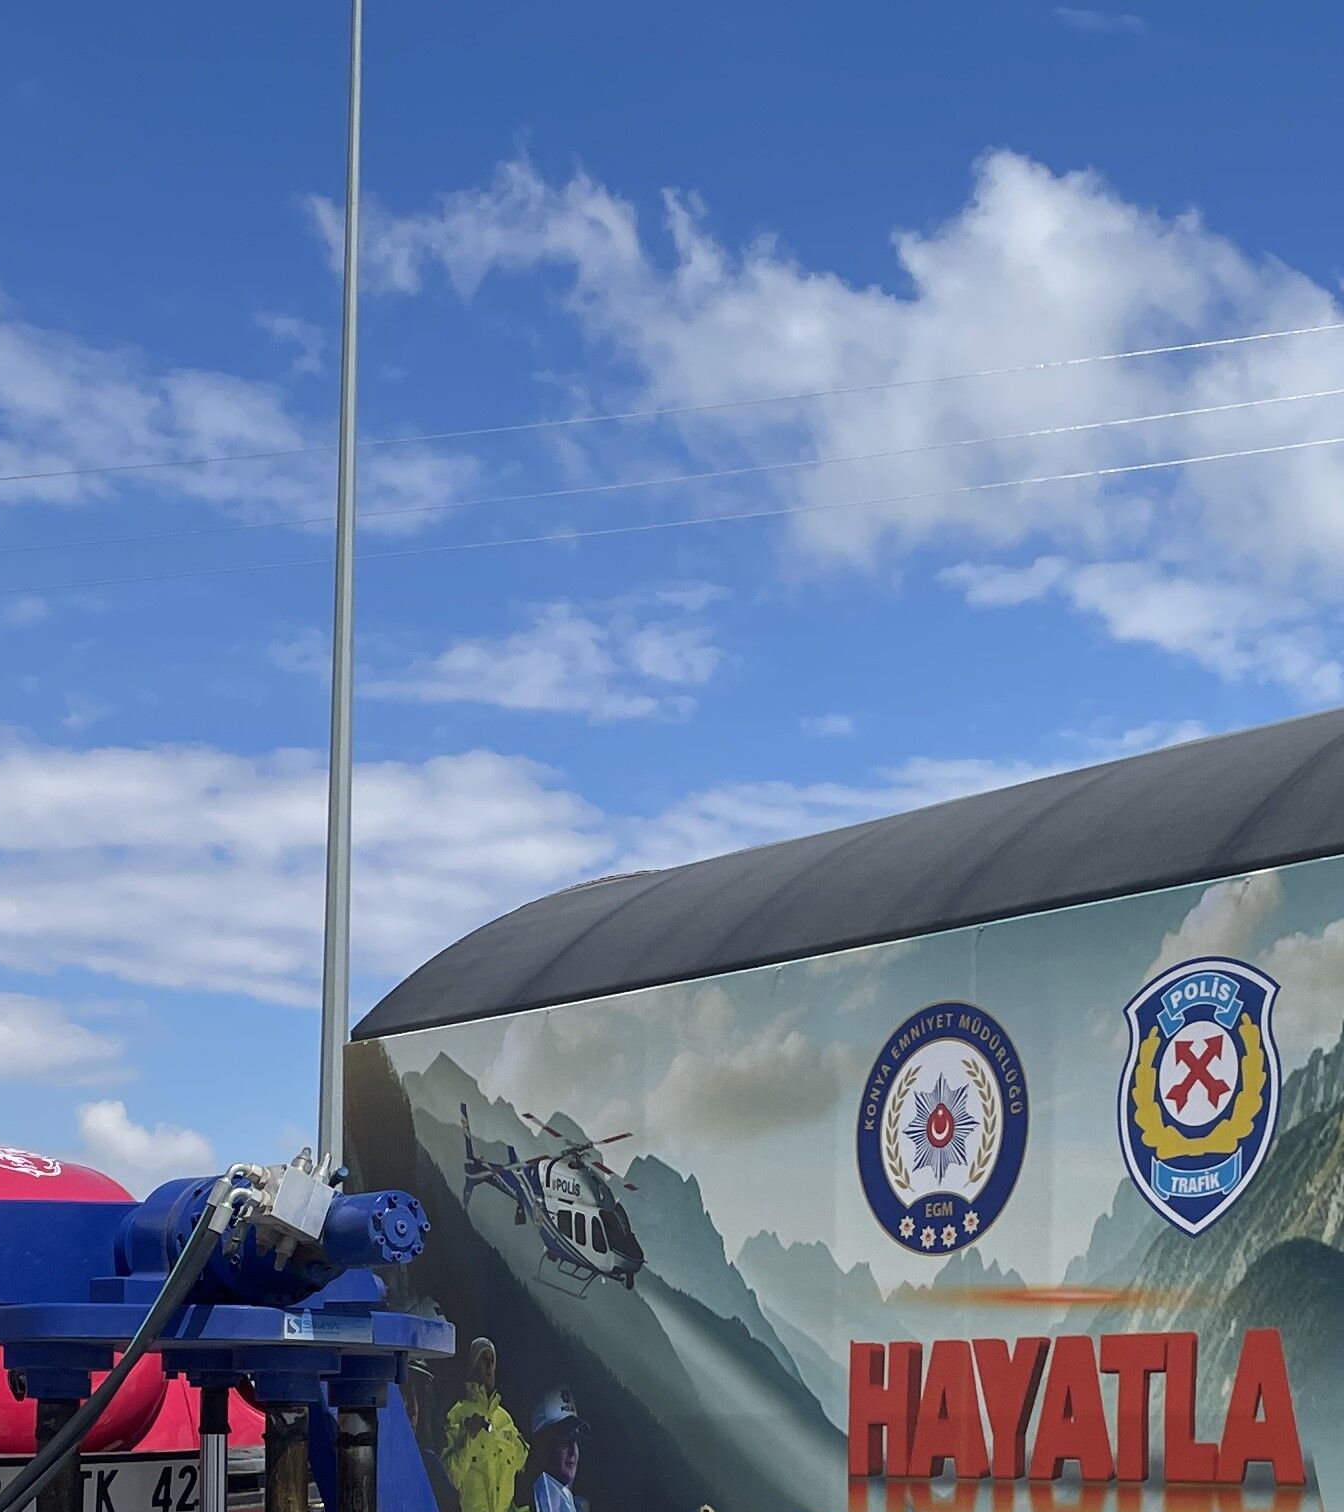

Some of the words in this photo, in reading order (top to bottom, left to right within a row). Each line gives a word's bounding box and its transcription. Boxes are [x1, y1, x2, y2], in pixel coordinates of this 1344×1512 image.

[1169, 977, 1231, 1009] POLİS
[864, 1064, 892, 1131] KONYA
[891, 1013, 954, 1060] EMNİYET
[958, 1013, 1024, 1115] MÜDÜRLÜĞÜ
[1171, 1172, 1221, 1194] TRAFİK
[925, 1201, 953, 1218] EGM
[848, 1328, 1306, 1484] HAYATLA
